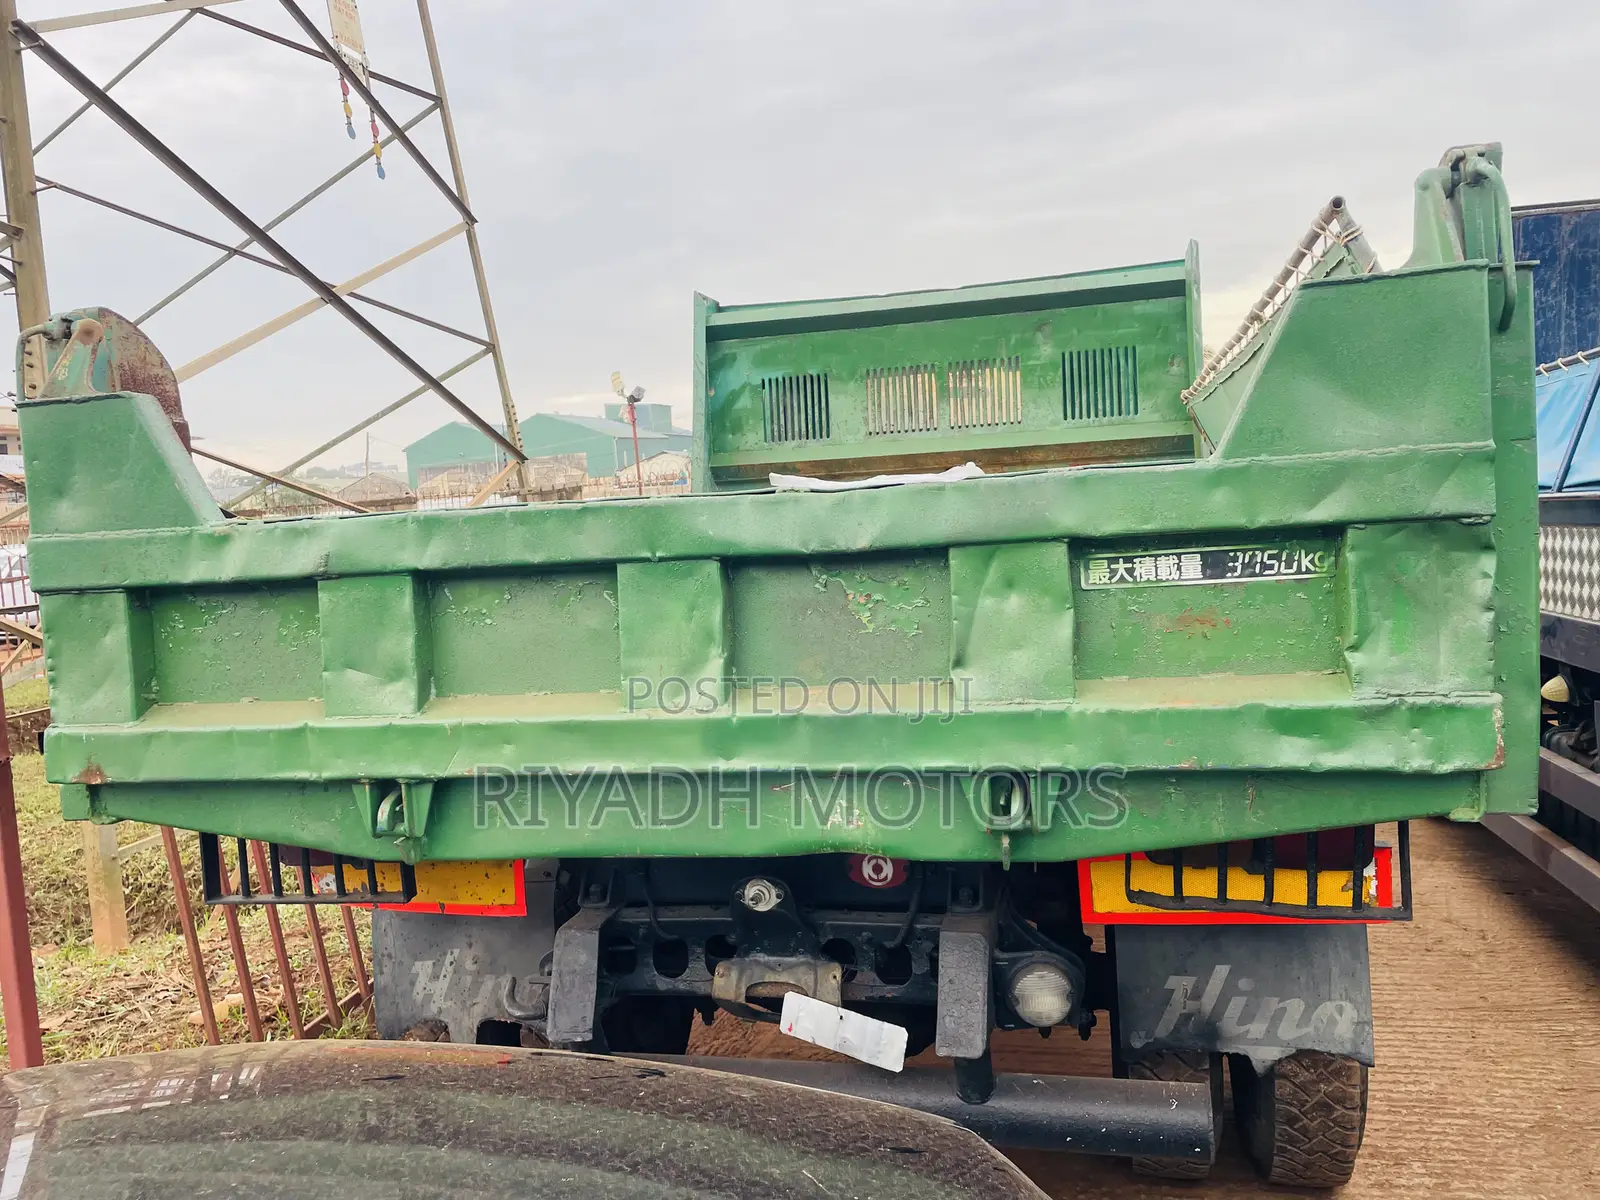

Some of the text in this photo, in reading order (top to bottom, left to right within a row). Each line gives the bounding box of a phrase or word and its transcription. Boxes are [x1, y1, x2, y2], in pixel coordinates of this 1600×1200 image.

[1088, 554, 1203, 584] 最大積載量
[1130, 965, 1358, 1048] Hino
